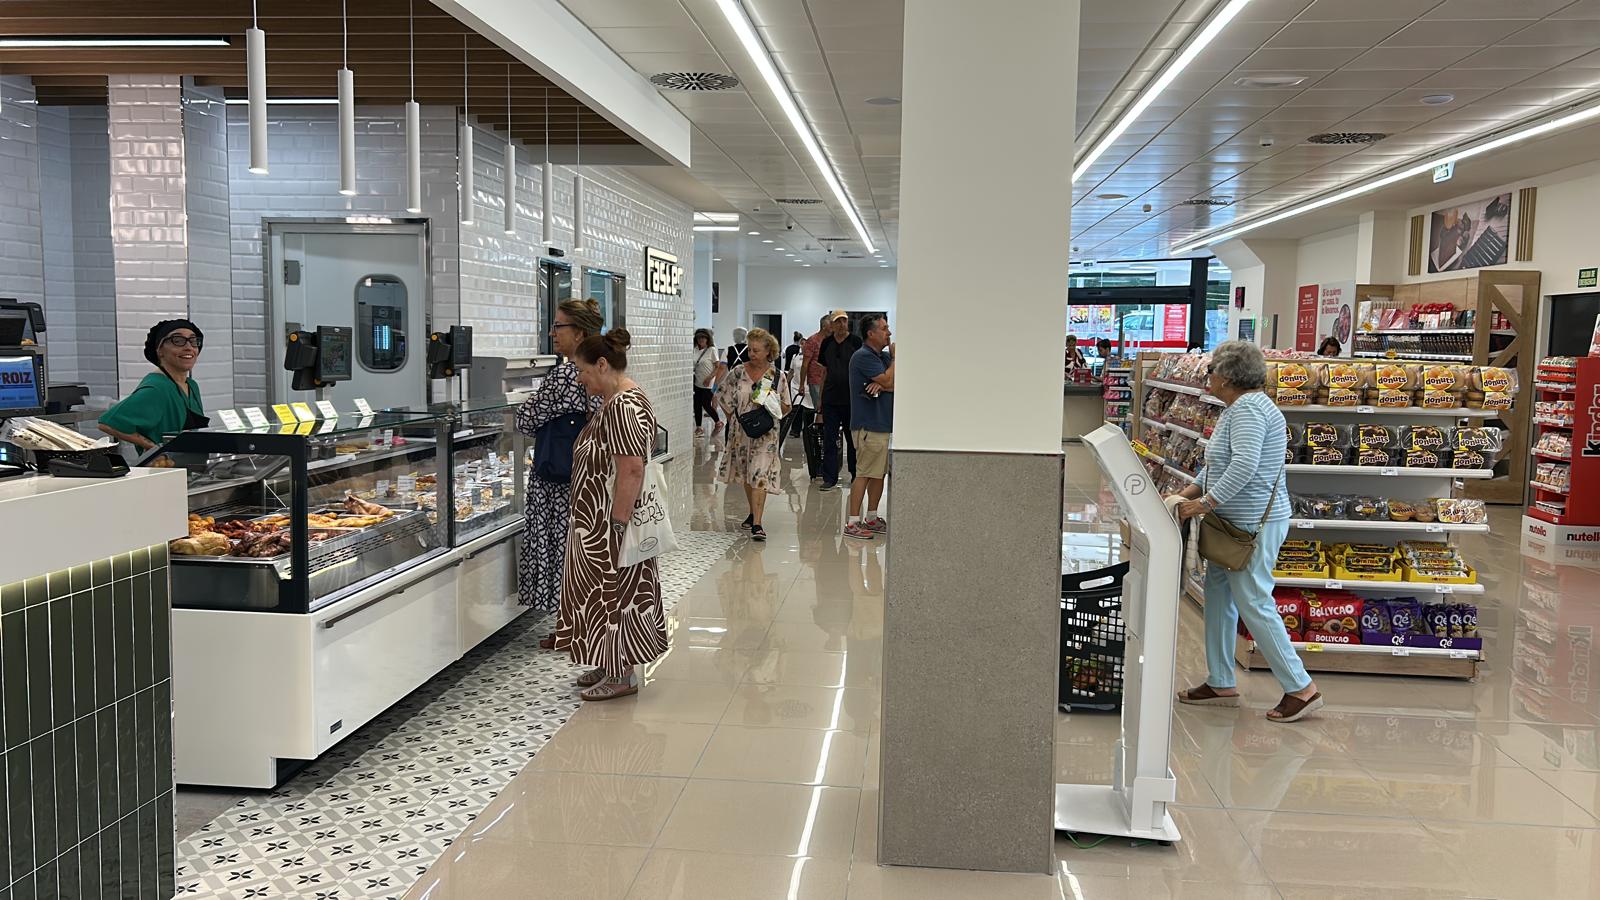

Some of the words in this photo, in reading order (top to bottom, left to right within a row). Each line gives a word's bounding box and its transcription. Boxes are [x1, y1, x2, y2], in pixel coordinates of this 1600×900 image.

[0, 371, 32, 384] ROIZ
[1279, 375, 1308, 383] donuts
[1378, 376, 1407, 384] donuts
[1425, 377, 1455, 385] donuts
[1484, 379, 1508, 387] donuts
[1277, 393, 1306, 402] donuts
[1329, 394, 1358, 403] donuts
[1379, 395, 1408, 404] donuts
[1424, 396, 1454, 405] donuts
[1308, 433, 1337, 442] donuts
[1361, 436, 1389, 444] donuts
[1413, 438, 1443, 446] donuts
[1460, 438, 1488, 447] donuts
[1313, 454, 1342, 462] donuts
[1360, 455, 1389, 464] donuts
[1407, 456, 1438, 465] donuts
[1454, 457, 1484, 466] donuts
[634, 490, 656, 509] alo
[1567, 532, 1600, 541] nutell
[1310, 604, 1354, 617] BOLLYCAO
[1362, 614, 1379, 628] Qé
[1393, 613, 1409, 627] Qé
[1315, 635, 1349, 643] BOLLYCAO
[1391, 634, 1405, 645] Qé
[1440, 638, 1453, 648] Qé
